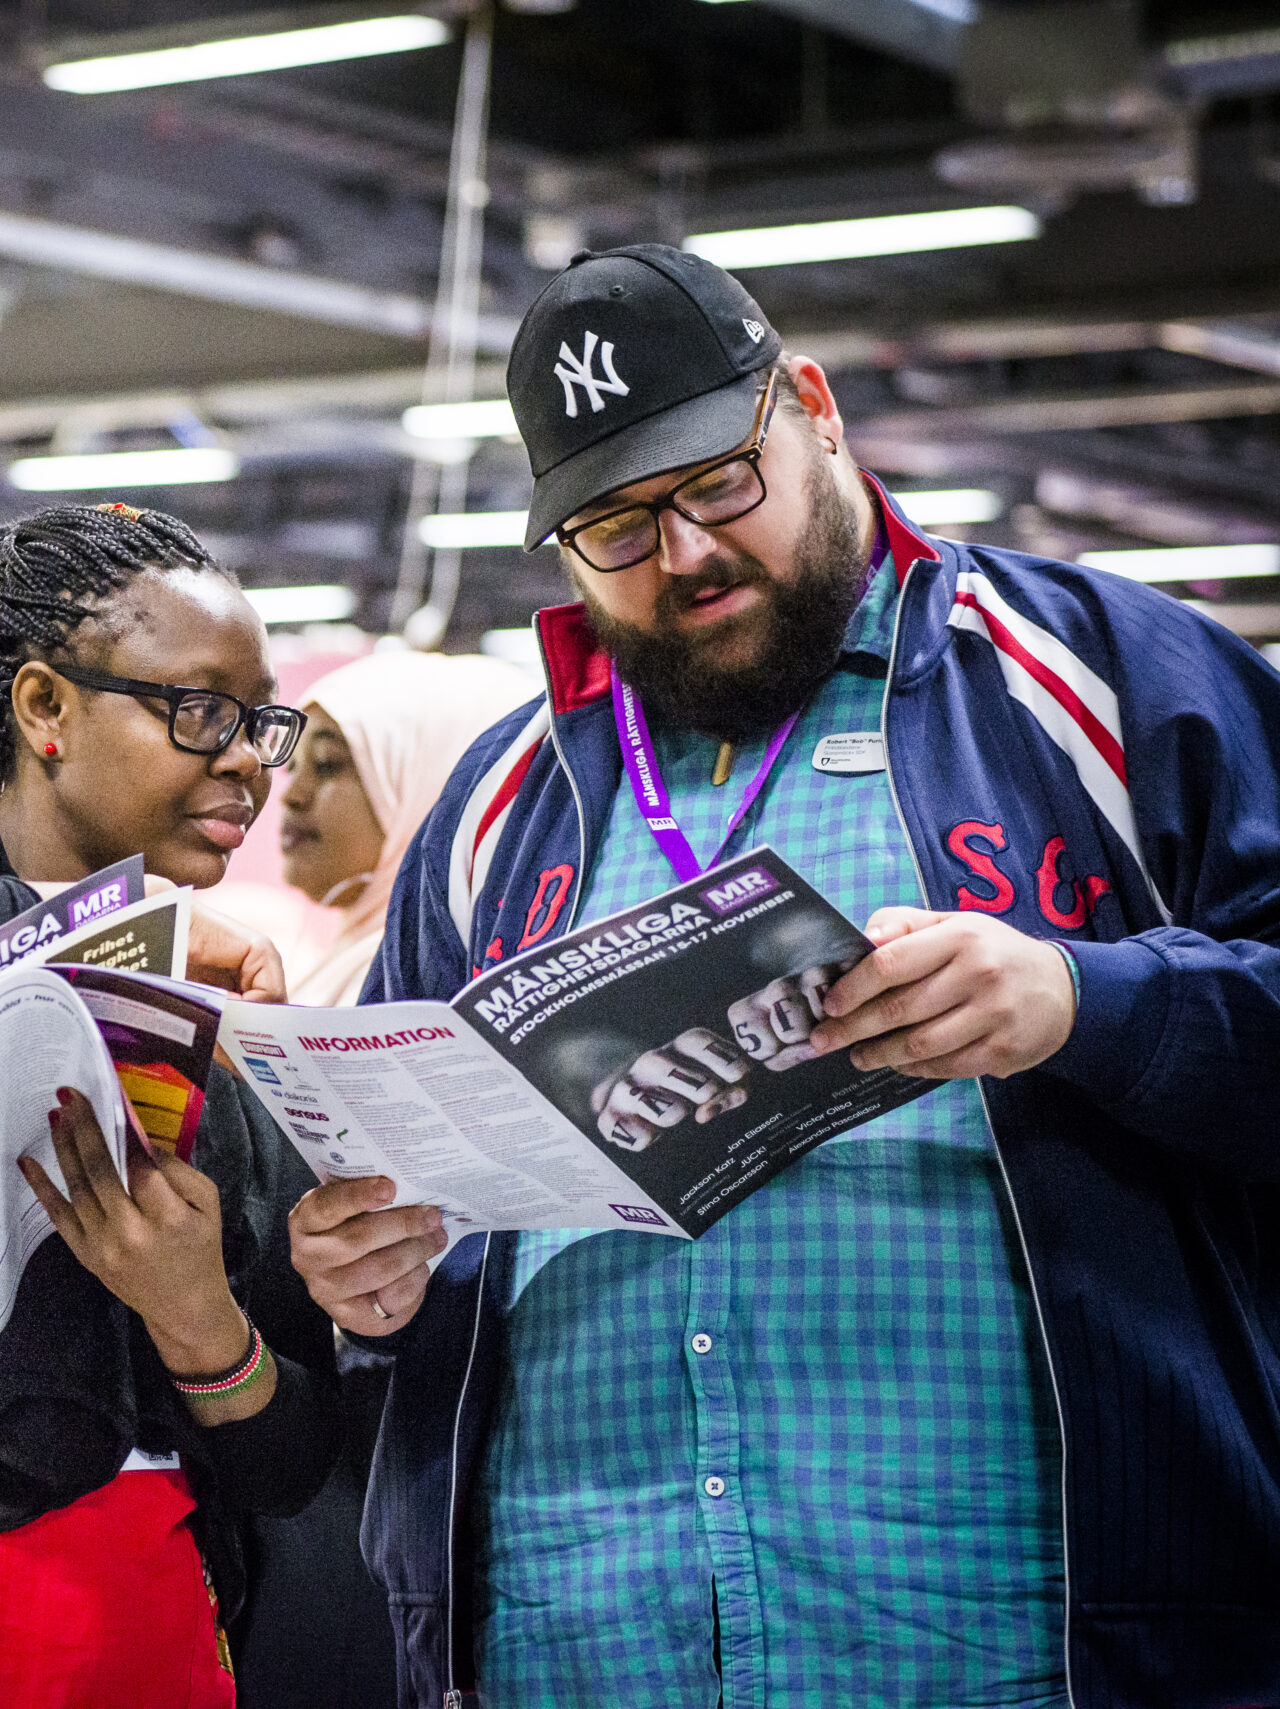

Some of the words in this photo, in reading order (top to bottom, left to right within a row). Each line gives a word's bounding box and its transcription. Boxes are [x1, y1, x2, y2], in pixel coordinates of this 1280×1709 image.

[554, 331, 630, 418] NY
[634, 748, 660, 806] MÄNSKLIGA
[73, 884, 121, 923] MR
[707, 871, 768, 906] MR
[721, 884, 772, 910] DAGARNA
[83, 931, 134, 963] Frihet
[474, 903, 701, 1022] MÄNSKLIGA
[510, 950, 666, 1044] STOCKHOLMSMÄSSAN
[668, 931, 708, 954] 15-17
[711, 890, 795, 935] NOVEMBER
[493, 915, 711, 1034] RÄTTIGHETSDAGARNA
[297, 1027, 456, 1052] INFORMATION
[727, 1138, 745, 1153] Jan
[744, 1112, 783, 1140] Eliasson
[789, 1126, 831, 1154] Alexandra
[832, 1103, 881, 1129] Pascalidou
[795, 1113, 826, 1131] Victor
[826, 1101, 853, 1116] Olisa
[680, 1173, 715, 1205] Jackson
[714, 1157, 736, 1174] Katz
[697, 1196, 721, 1215] Stina
[720, 1160, 768, 1197] Oscarsson
[614, 1206, 658, 1220] MR
